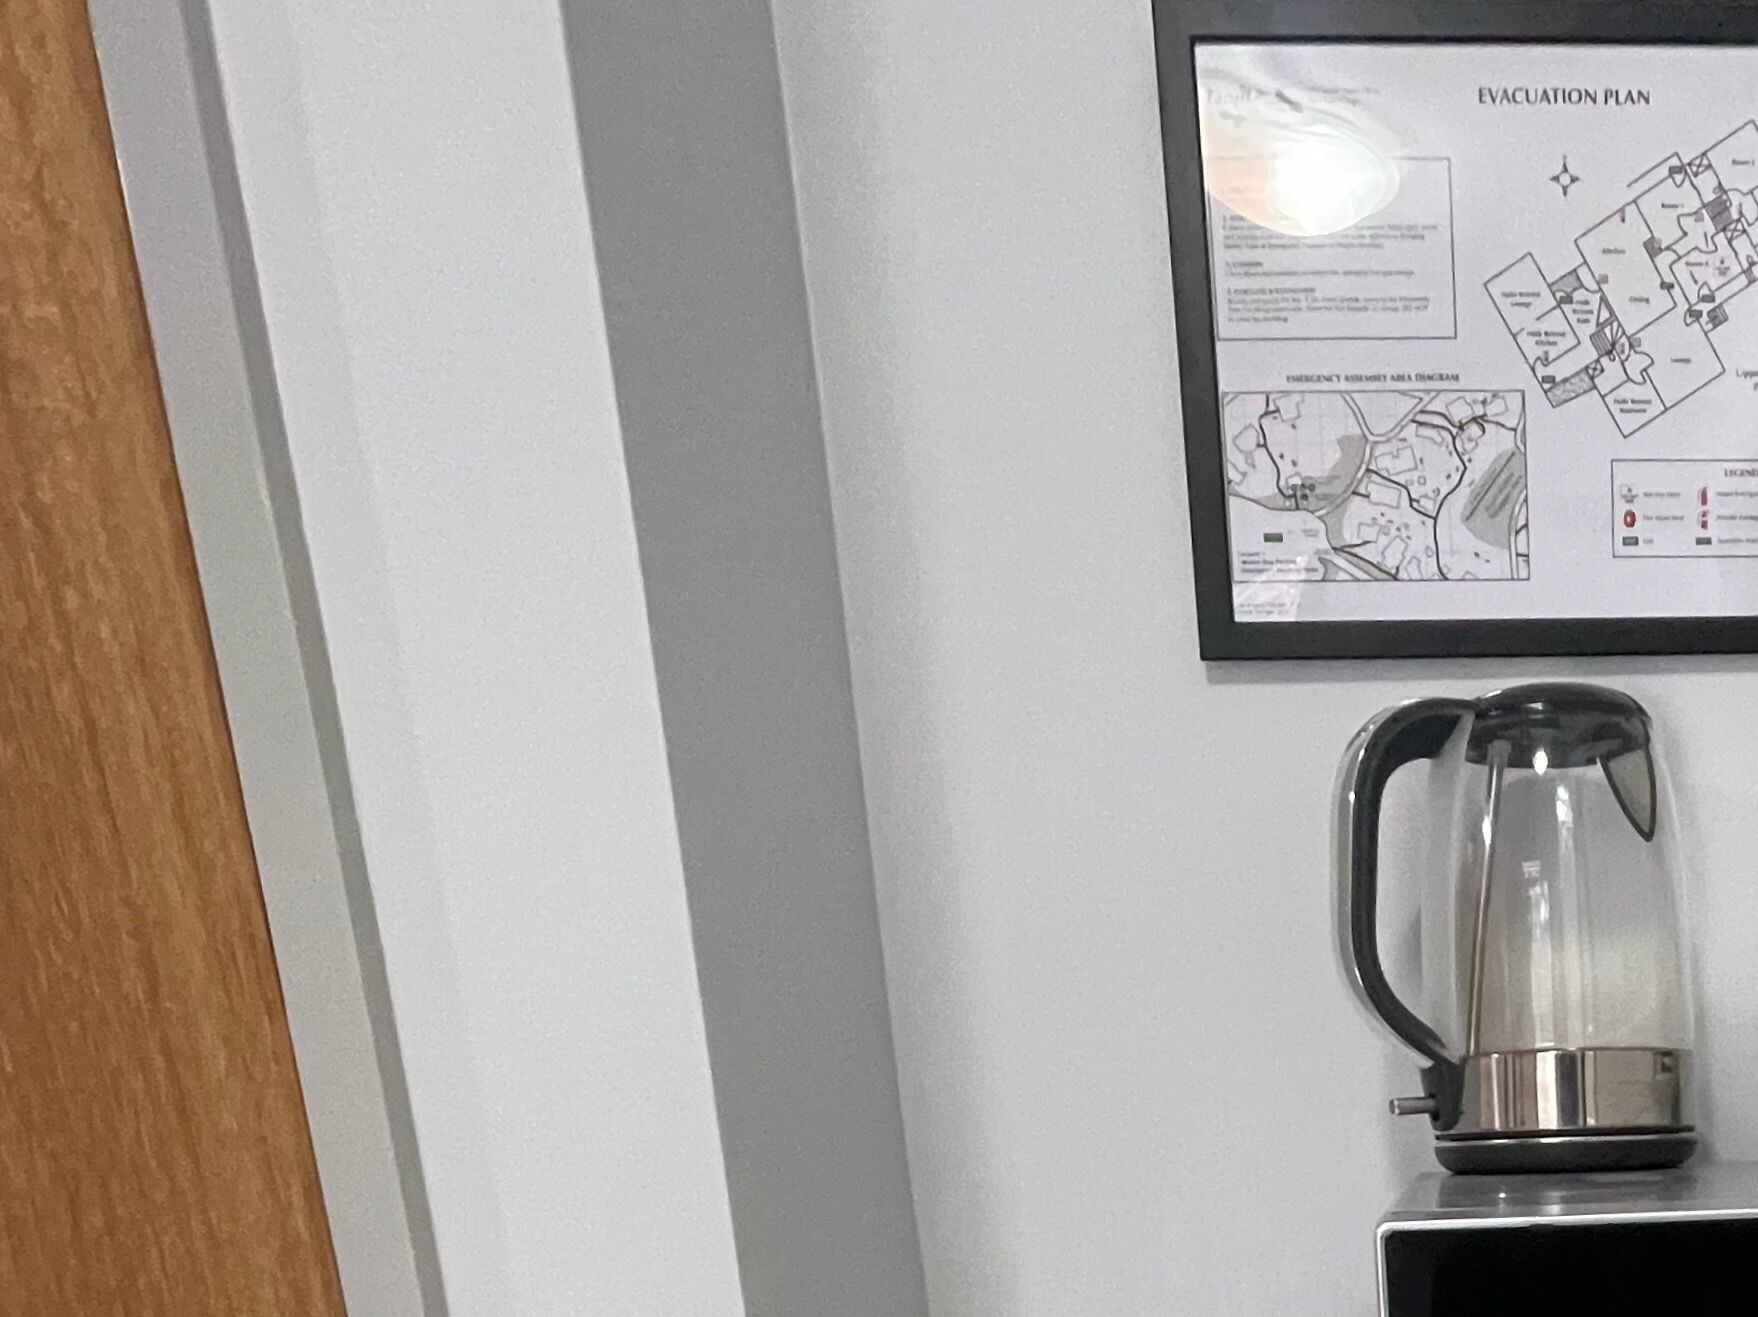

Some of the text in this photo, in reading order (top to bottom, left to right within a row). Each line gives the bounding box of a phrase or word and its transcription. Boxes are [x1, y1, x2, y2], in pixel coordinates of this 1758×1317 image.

[1478, 86, 1651, 106] EVACUATION PLAN
[1286, 373, 1341, 384] EMERGENCY
